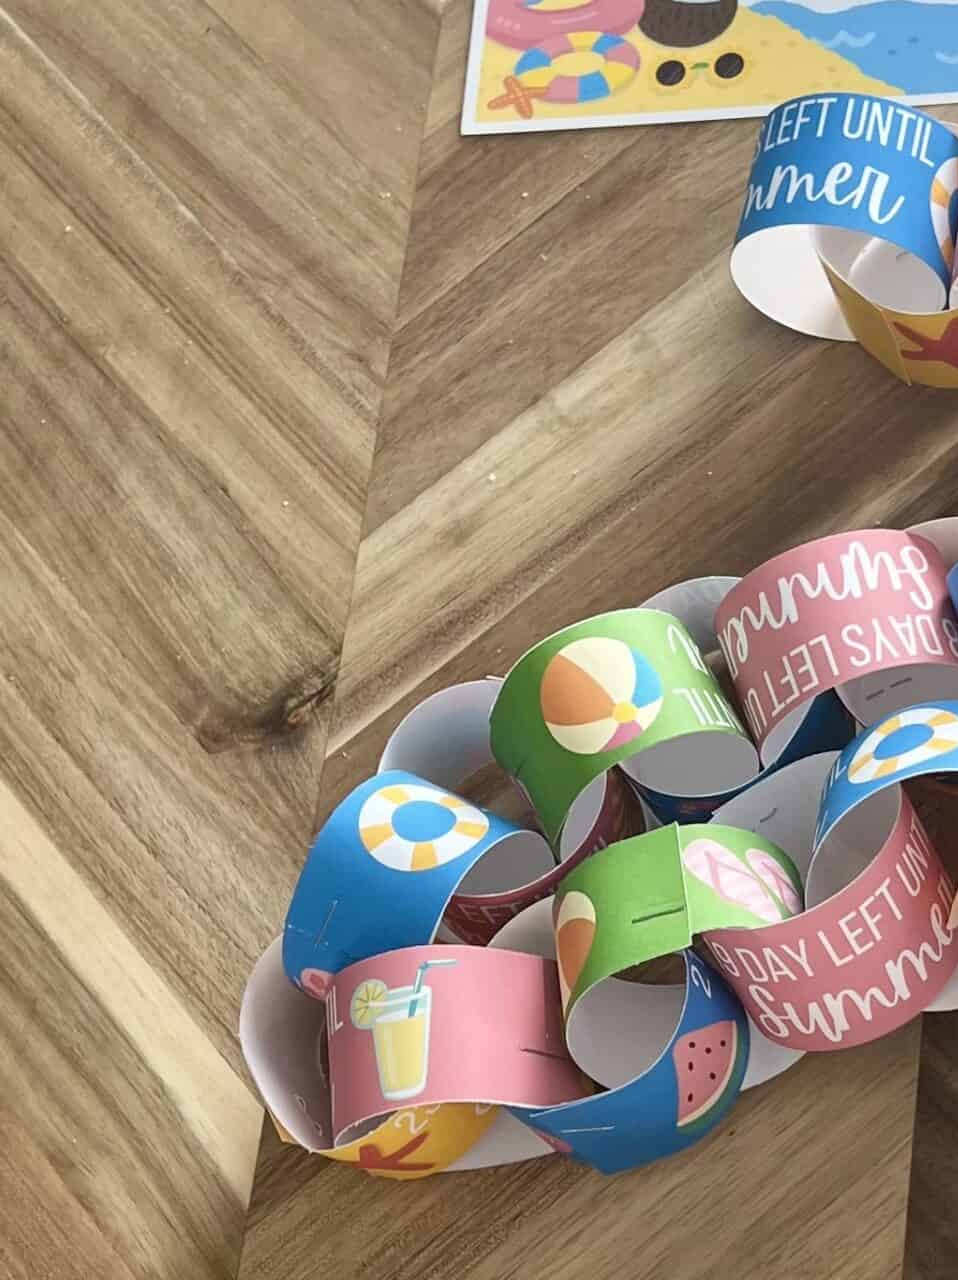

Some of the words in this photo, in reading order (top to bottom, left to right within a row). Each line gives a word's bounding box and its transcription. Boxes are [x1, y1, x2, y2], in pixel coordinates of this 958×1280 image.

[763, 97, 838, 153] LEFT
[841, 98, 935, 168] UNTIL
[744, 161, 905, 225] mmer
[762, 633, 840, 718] LEFT
[841, 613, 944, 668] DAYS
[734, 938, 815, 984] DAY
[817, 877, 904, 968] LEFT
[895, 812, 932, 898] UNT
